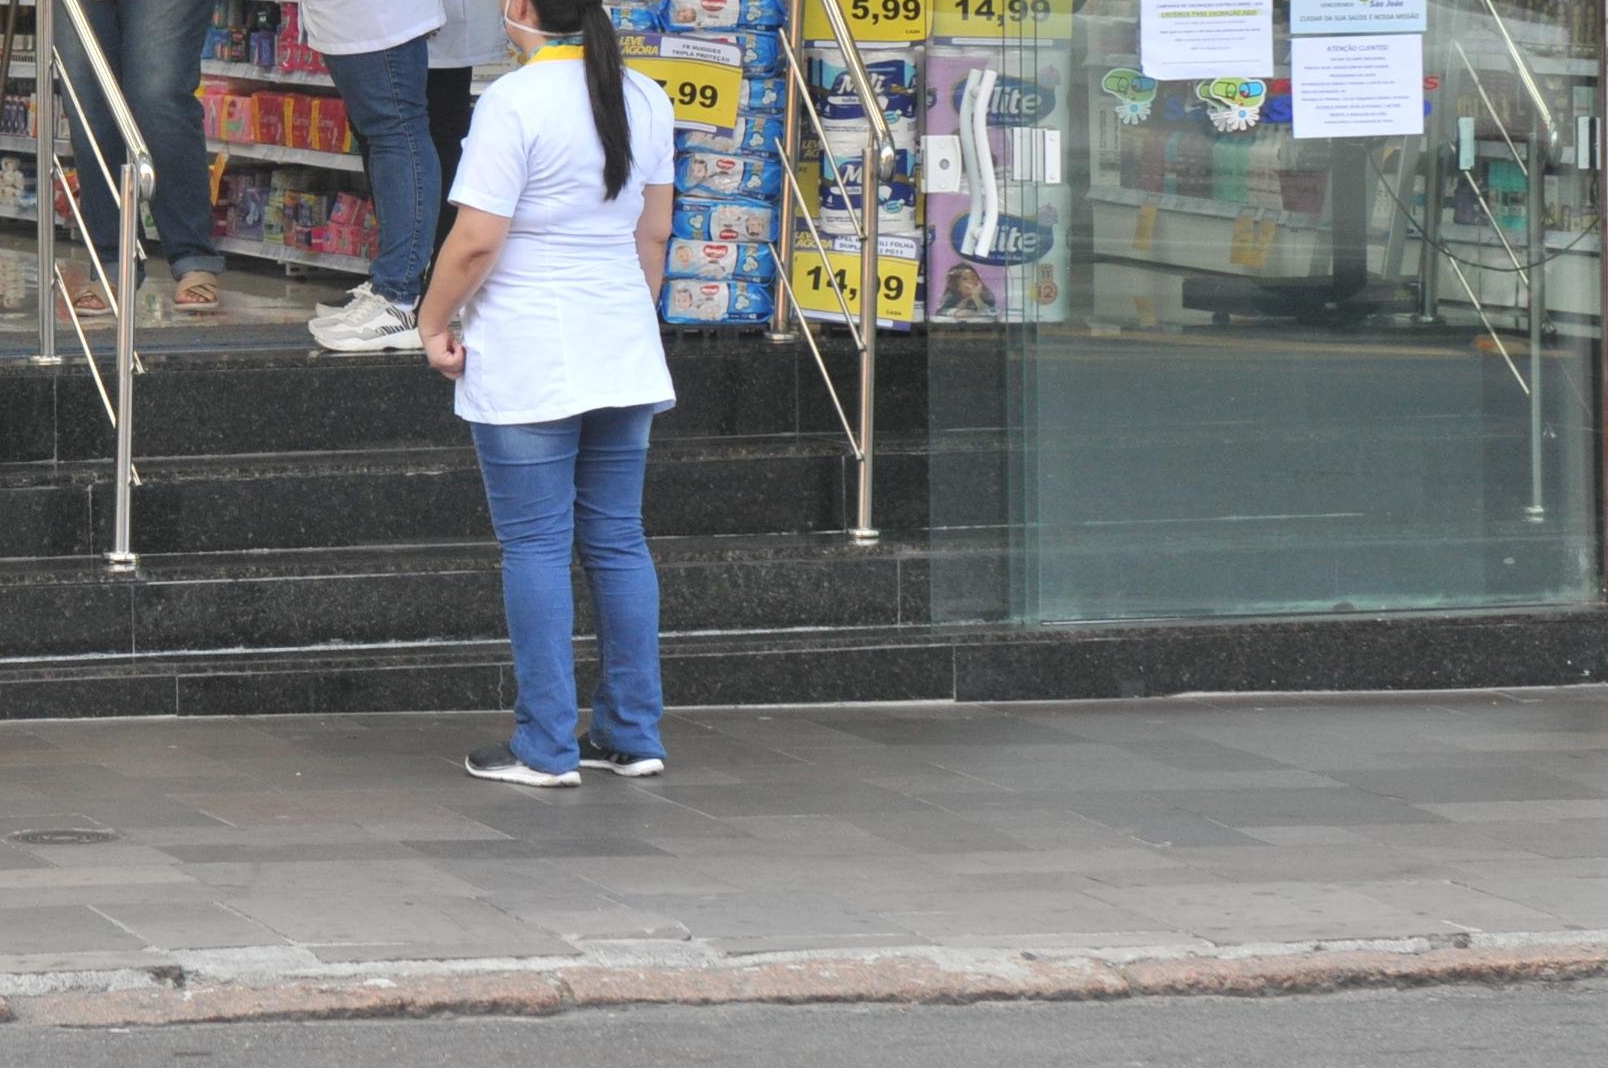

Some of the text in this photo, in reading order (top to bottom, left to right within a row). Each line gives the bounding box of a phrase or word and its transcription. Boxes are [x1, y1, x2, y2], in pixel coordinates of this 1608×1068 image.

[620, 36, 645, 45] LEVE
[622, 44, 659, 55] AGORA
[696, 52, 731, 63] PROTEÇÃO
[807, 266, 904, 301] 14,9
